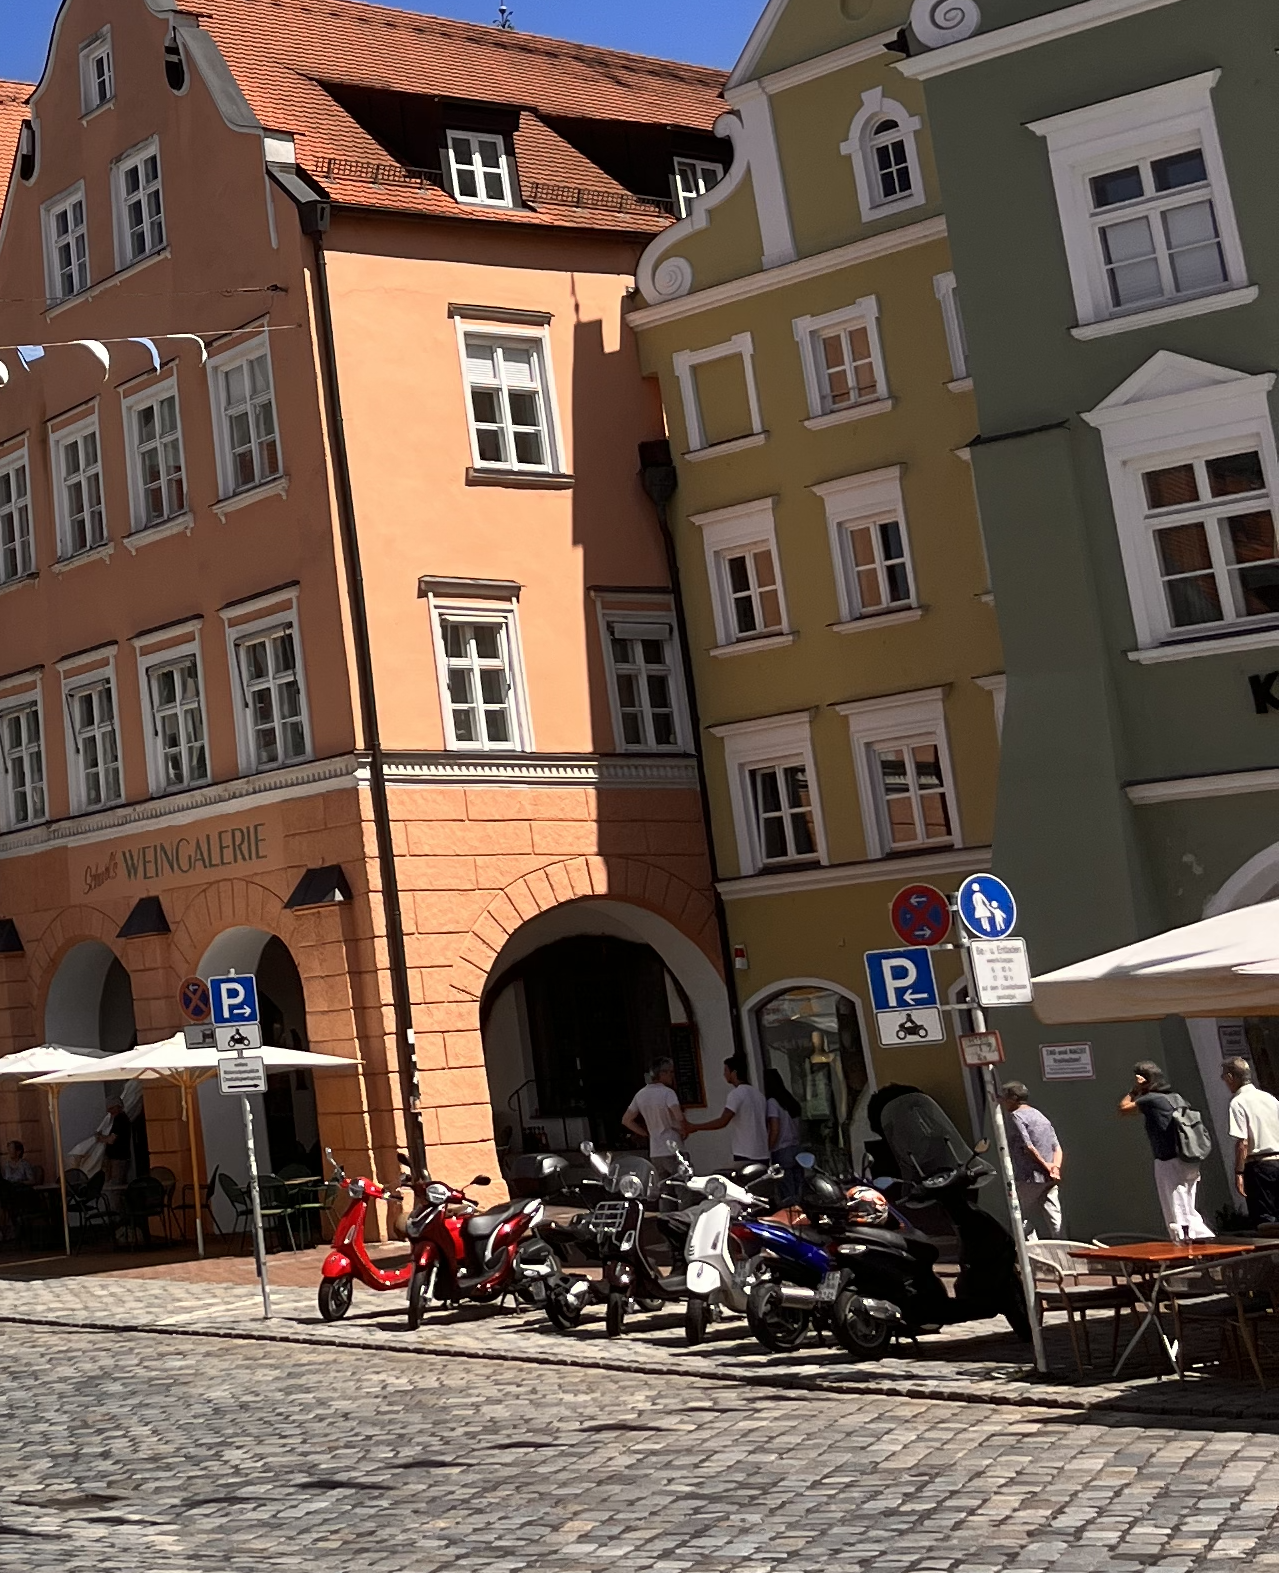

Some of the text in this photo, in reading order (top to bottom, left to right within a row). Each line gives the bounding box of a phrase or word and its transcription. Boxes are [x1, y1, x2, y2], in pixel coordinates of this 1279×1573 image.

[122, 823, 268, 882] WEINGALERIE
[220, 982, 245, 1019] P
[881, 957, 917, 1007] P
